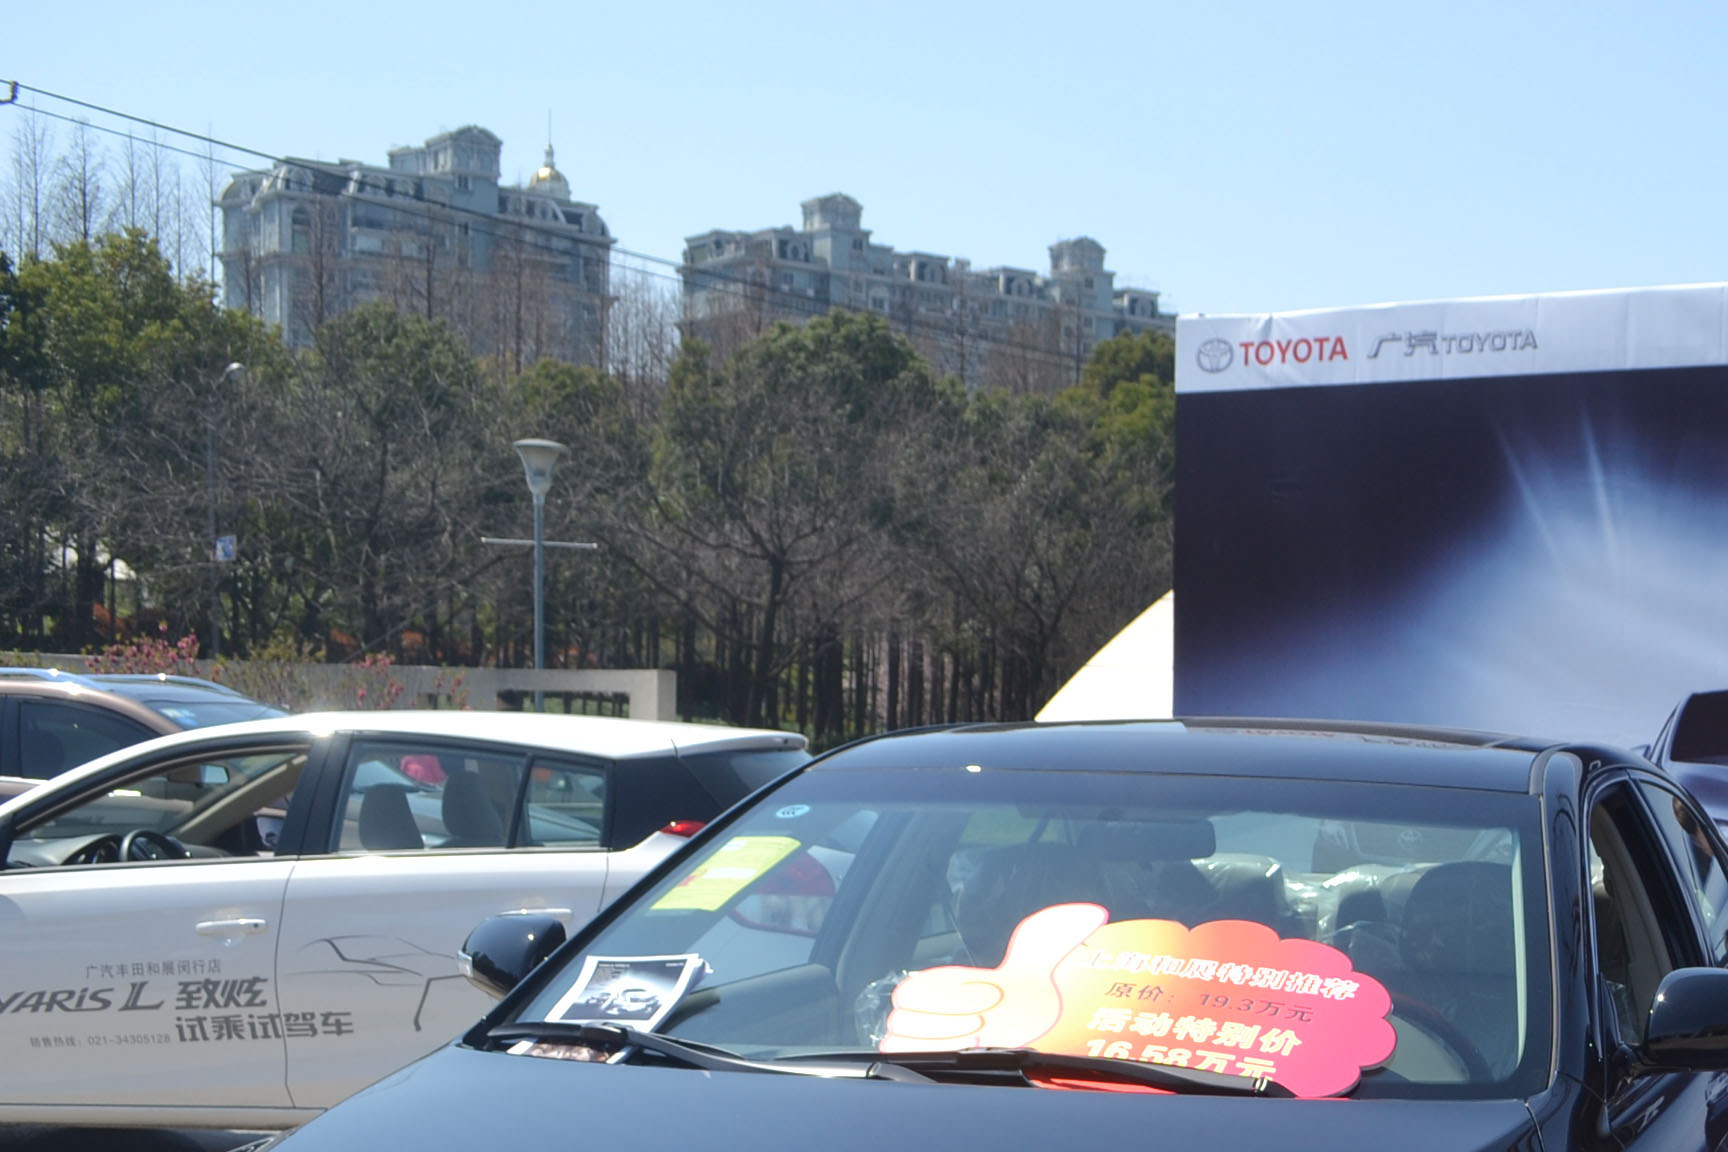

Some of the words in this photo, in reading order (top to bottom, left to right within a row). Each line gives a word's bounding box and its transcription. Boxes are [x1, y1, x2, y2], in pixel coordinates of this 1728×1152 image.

[1239, 335, 1348, 367] TOYOTA
[175, 975, 269, 1010] 致炫
[174, 1011, 355, 1043] 试乘试驾车
[1085, 1007, 1303, 1057] 活动特别价
